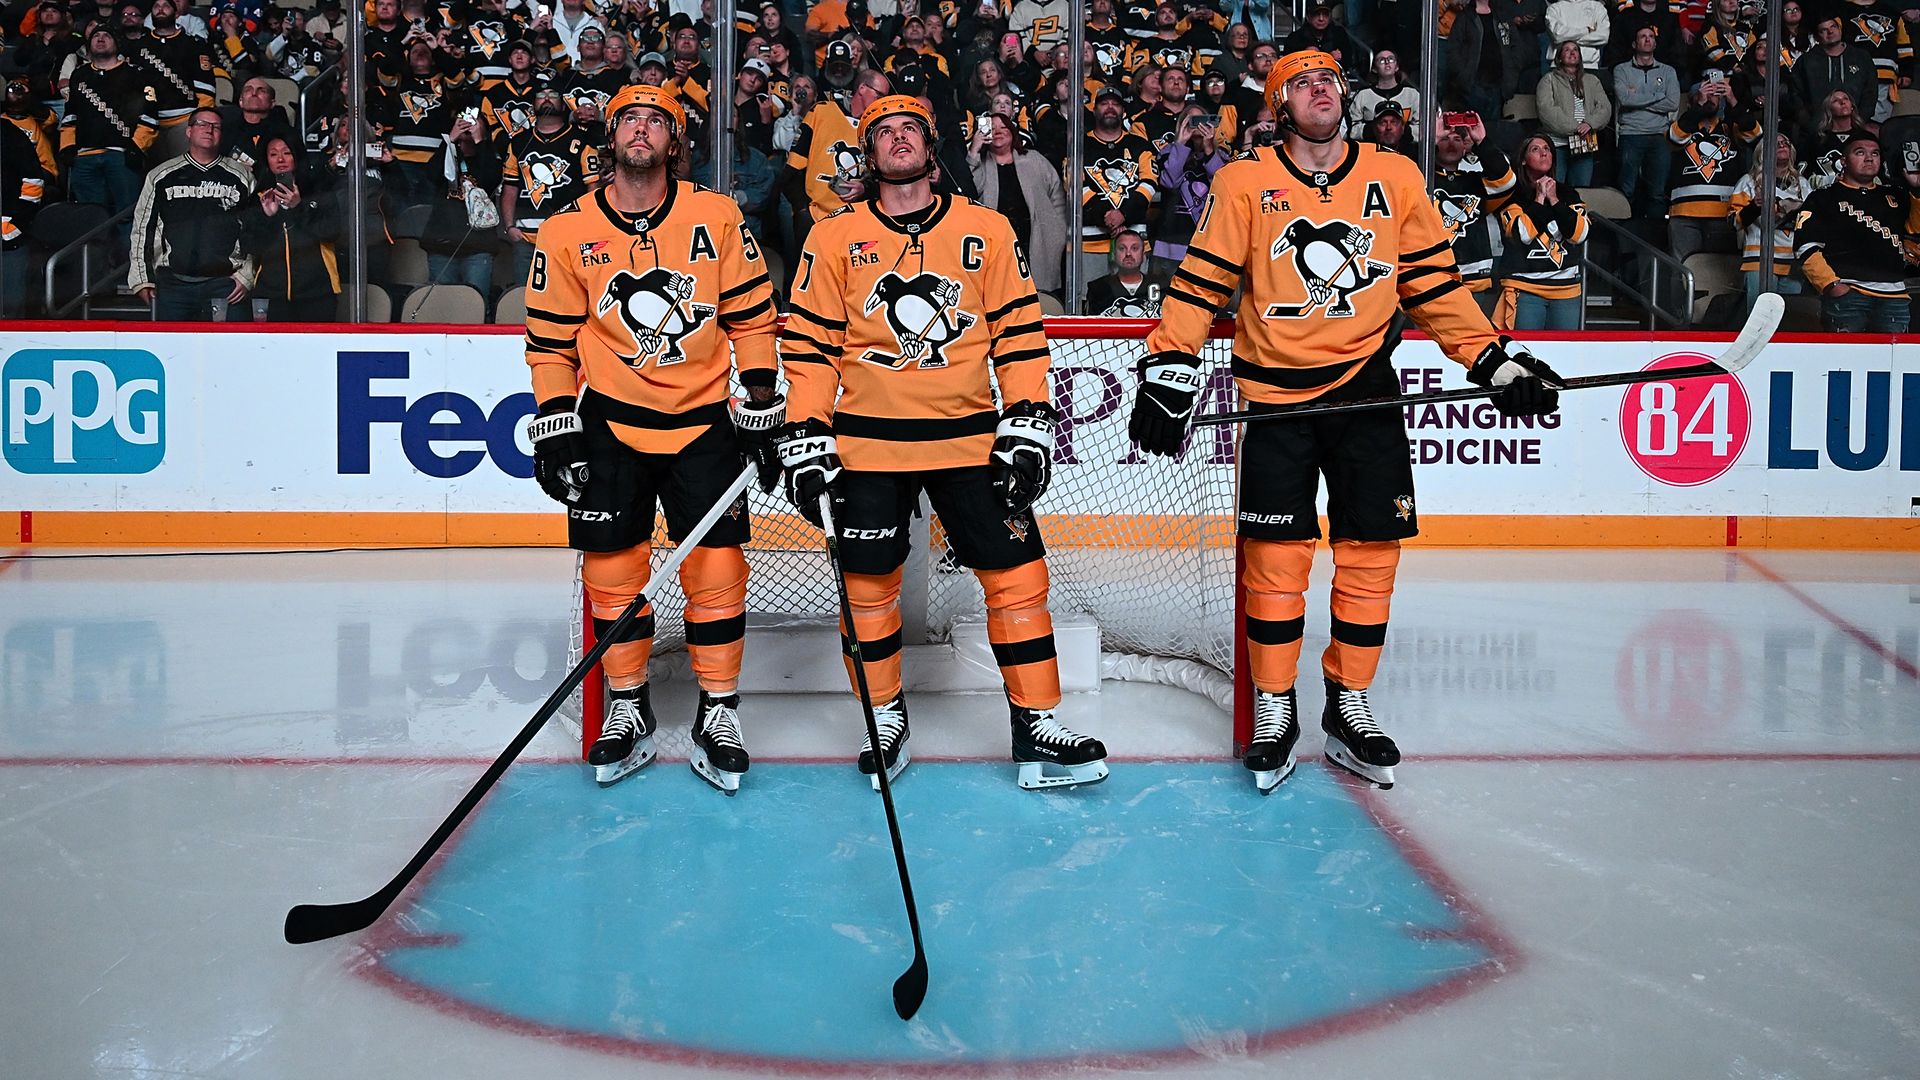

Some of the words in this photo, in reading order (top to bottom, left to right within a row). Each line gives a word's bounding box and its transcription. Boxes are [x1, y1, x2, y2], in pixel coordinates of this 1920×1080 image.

[1032, 15, 1059, 46] P
[140, 47, 194, 101] PITTSBURGH
[144, 86, 157, 102] 3
[78, 81, 131, 138] PITTSBURGH
[570, 139, 582, 155] C
[586, 155, 600, 172] 8
[165, 185, 241, 203] PENGUINS
[1361, 180, 1392, 219] A
[688, 223, 719, 264] A
[737, 221, 760, 262] 5
[961, 234, 985, 272] C
[531, 249, 549, 293] 8
[581, 253, 612, 268] F.N.B.
[797, 250, 815, 293] 7
[850, 252, 881, 268] F.N.B.
[1149, 283, 1160, 301] C
[9, 360, 159, 463] PPG
[1035, 409, 1046, 419] 87
[1636, 382, 1733, 456] 84
[1767, 370, 1920, 472] LU
[795, 429, 806, 438] 87
[843, 526, 898, 540] CCM
[1034, 745, 1059, 757] CCM
